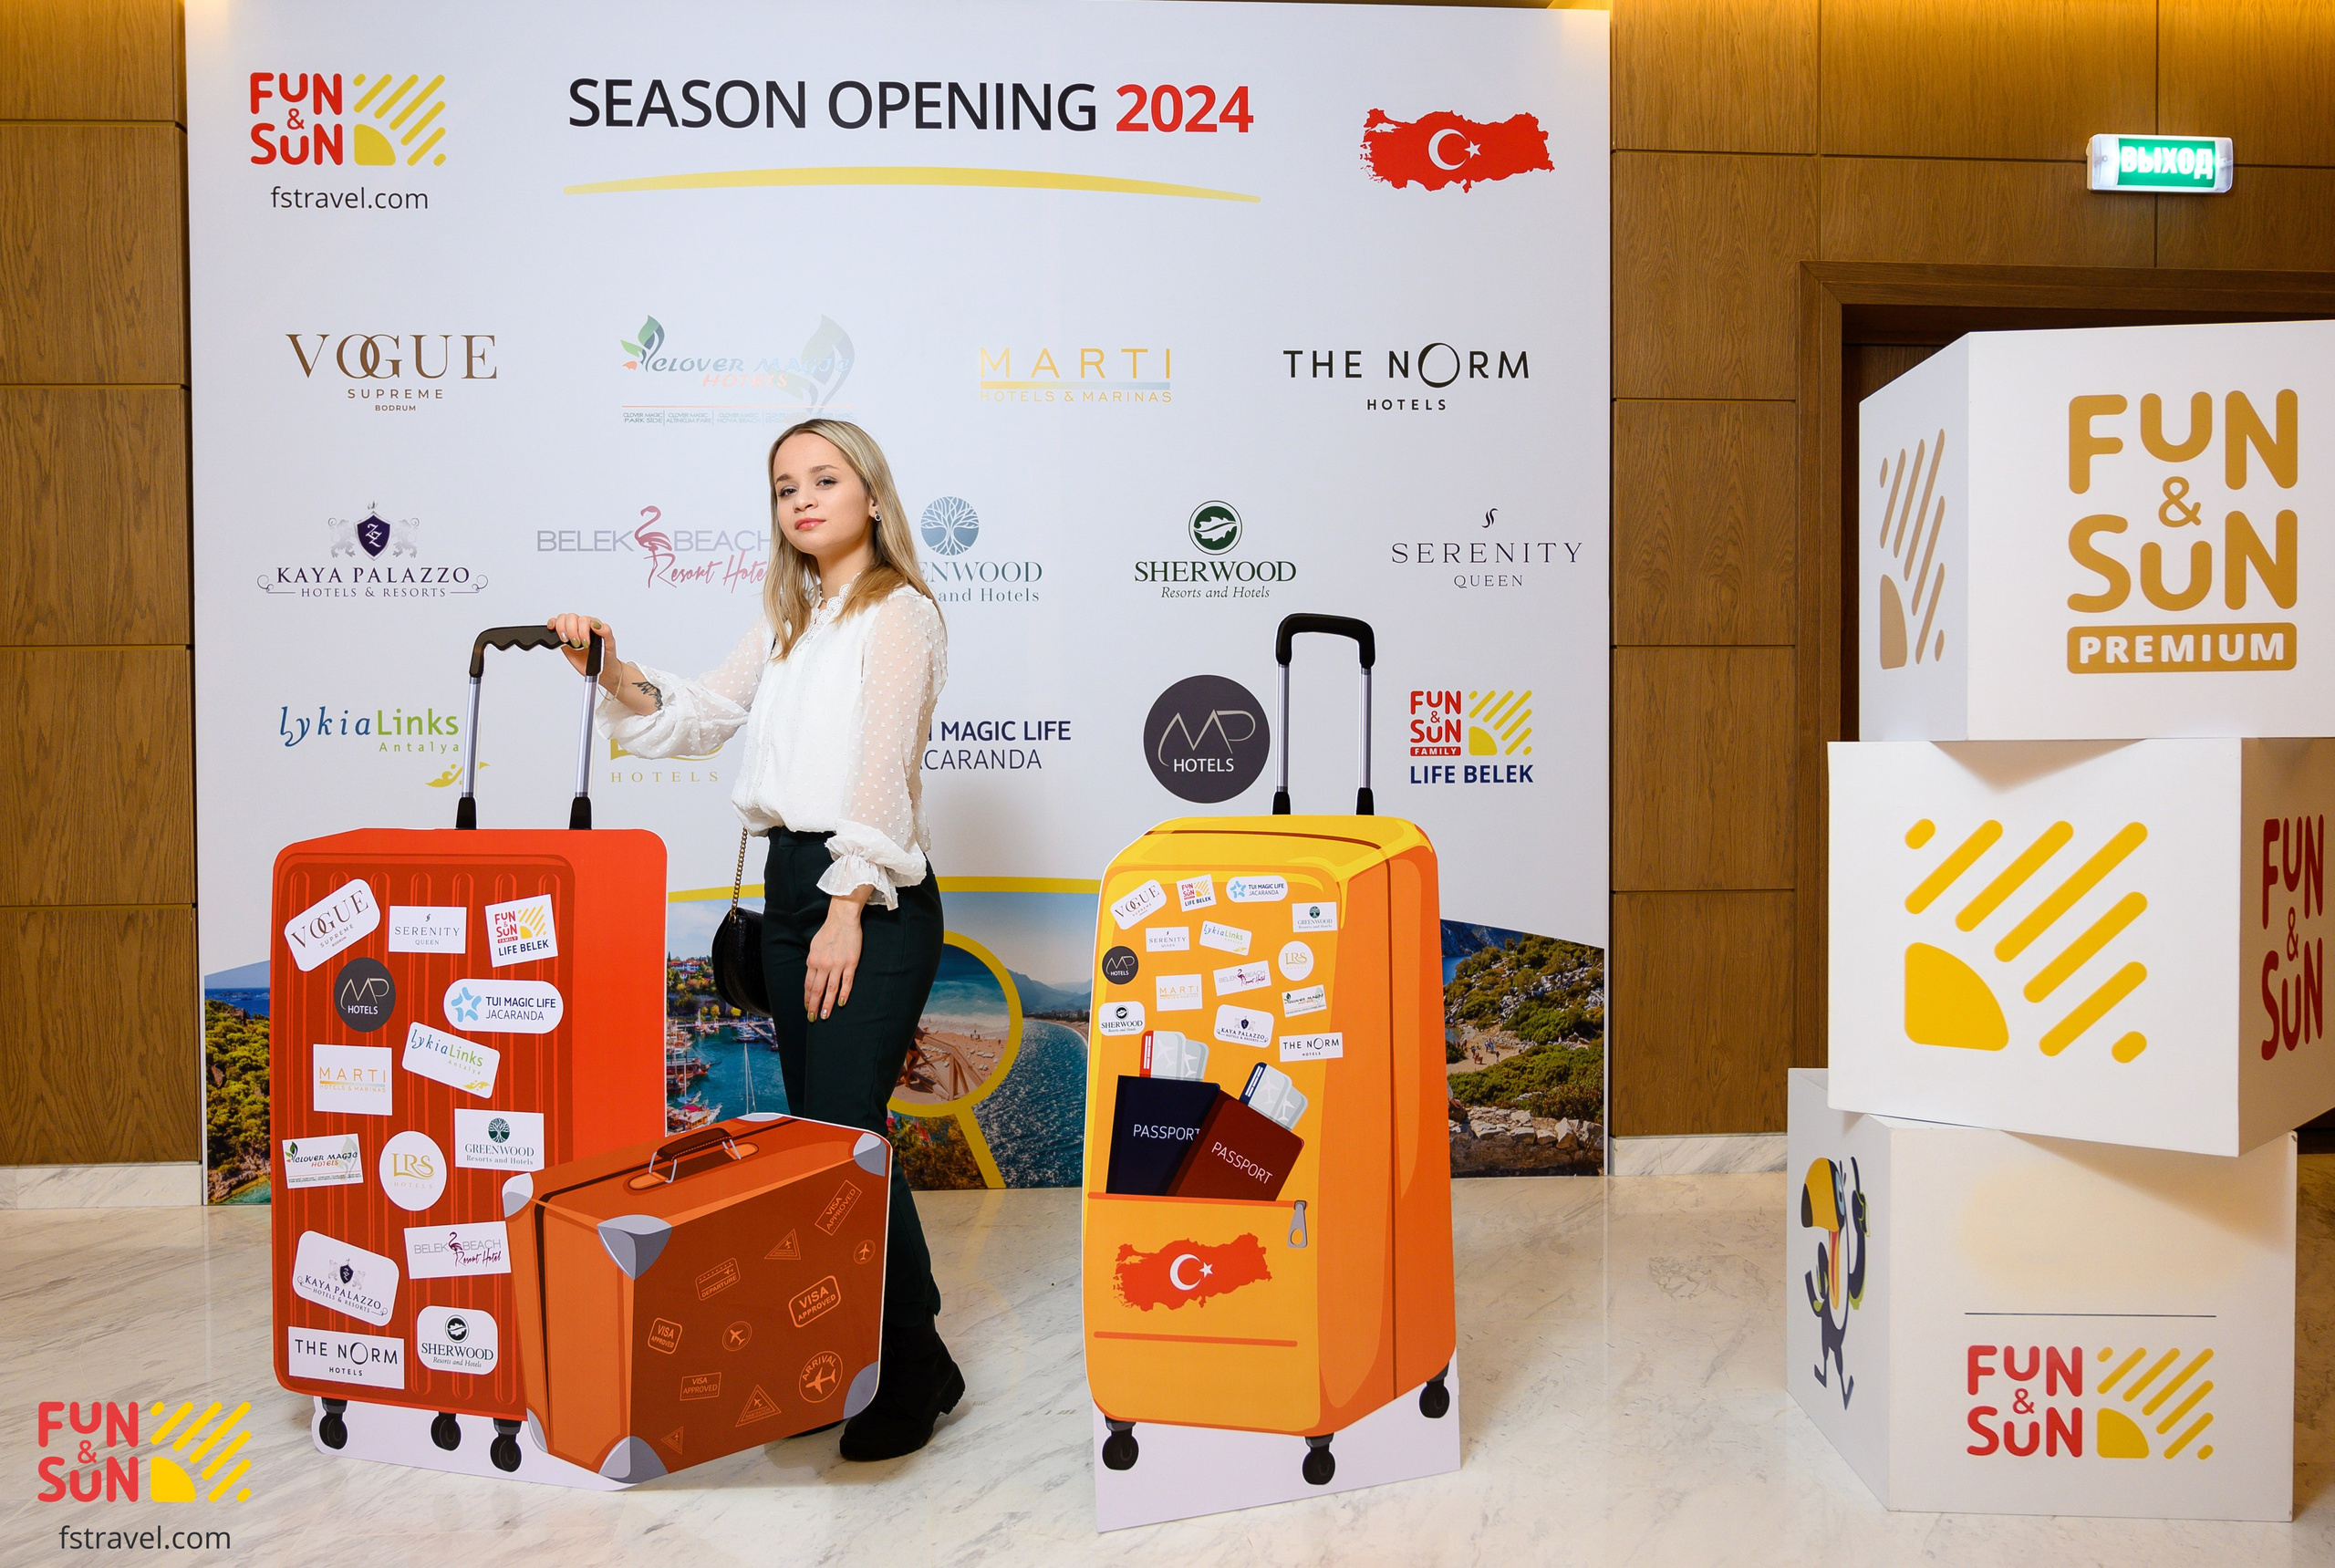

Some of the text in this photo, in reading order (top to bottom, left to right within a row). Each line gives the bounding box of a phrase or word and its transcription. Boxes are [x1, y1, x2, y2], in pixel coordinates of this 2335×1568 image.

[251, 72, 343, 115] FUN
[569, 78, 1254, 133] SEASON OPENING 2024
[287, 109, 305, 130] &
[251, 123, 343, 166] SUN
[2121, 146, 2214, 180] ВЫХОД
[271, 186, 429, 210] fstravel.com
[285, 334, 498, 379] VOGUE
[652, 358, 745, 372] CLOVER
[980, 348, 1171, 379] MARTI
[1283, 342, 1529, 388] THE NORM
[348, 389, 444, 399] SUPREME
[981, 391, 1173, 402] HOTELS & MARINAS
[1366, 399, 1447, 410] HOTELS
[2069, 389, 2298, 494] FUN
[2158, 476, 2202, 528] &
[537, 530, 635, 552] BELEK
[1391, 541, 1583, 564] SERENITY
[2067, 509, 2298, 613] SUN
[277, 567, 471, 584] KAYA PALAZZO
[644, 548, 767, 593] Resort Hote
[918, 562, 1043, 583] ENWOOD
[1135, 561, 1297, 584] SHERWOOD
[301, 587, 446, 597] HOTELS & RESORTS
[1161, 586, 1271, 598] Resorts and Hotels
[1454, 575, 1524, 588] QUEEN
[939, 588, 1039, 602] and Hotels
[2080, 633, 2284, 664] PREMIUM
[1410, 691, 1461, 715] FUN
[1430, 711, 1440, 723] &
[941, 721, 1016, 741] MAGIC
[1023, 721, 1072, 741] LIFE
[1410, 719, 1461, 743] SUN
[379, 742, 459, 753] Antalya
[919, 749, 1042, 770] CARANDA
[1173, 757, 1235, 774] HOTELS
[610, 772, 718, 783] HOTELS
[1410, 764, 1534, 784] LIFE BELEK
[2262, 814, 2324, 929] FUN
[1115, 885, 1160, 918] VOGUE
[291, 889, 368, 949] VOGUE
[494, 910, 516, 925] FUN
[320, 923, 354, 949] SUPREME
[394, 927, 461, 937] SERENITY
[2286, 906, 2299, 961] &
[498, 940, 549, 957] LIFE BELEK
[1159, 986, 1199, 994] MARTI
[2260, 937, 2323, 1061] SUN
[348, 1005, 379, 1015] HOTELS
[485, 996, 556, 1008] TUI MAGIC LIFE
[485, 1009, 545, 1021] JACARANDA
[1101, 1021, 1143, 1029] SHERWOOD
[1238, 1030, 1265, 1040] PALAZZO
[1283, 1038, 1339, 1050] THE NORM
[319, 1067, 386, 1083] MARTI
[448, 1059, 482, 1075] Antalya
[295, 1155, 324, 1163] CLOVER
[464, 1143, 534, 1157] GREENWOOD
[466, 1155, 493, 1163] Resorts
[391, 1153, 435, 1179] LRS
[1211, 1141, 1273, 1185] PASSPORT
[825, 1197, 843, 1215] VISA
[826, 1189, 856, 1231] APPROVED
[414, 1239, 502, 1254] BELEK BEACH
[305, 1274, 381, 1310] KAYA PALAZZO
[701, 1274, 738, 1297] DEPARTURE
[313, 1288, 336, 1301] HOTELS
[344, 1299, 370, 1314] RESORTS
[797, 1293, 836, 1322] APPROVED
[799, 1286, 829, 1309] VISA
[651, 1335, 675, 1349] APPROVED
[658, 1324, 674, 1339] VISA
[295, 1339, 398, 1365] THE NORM
[420, 1343, 493, 1361] SHERWOOD
[433, 1356, 482, 1368] Resorts and Hotels
[329, 1366, 363, 1376] HOTELS
[803, 1355, 836, 1381] ARRIVAL
[1967, 1345, 2083, 1397] FUN
[683, 1384, 718, 1395] APPROVED
[692, 1376, 708, 1385] VISA
[2013, 1388, 2035, 1415] &
[1967, 1406, 2083, 1459] SUN
